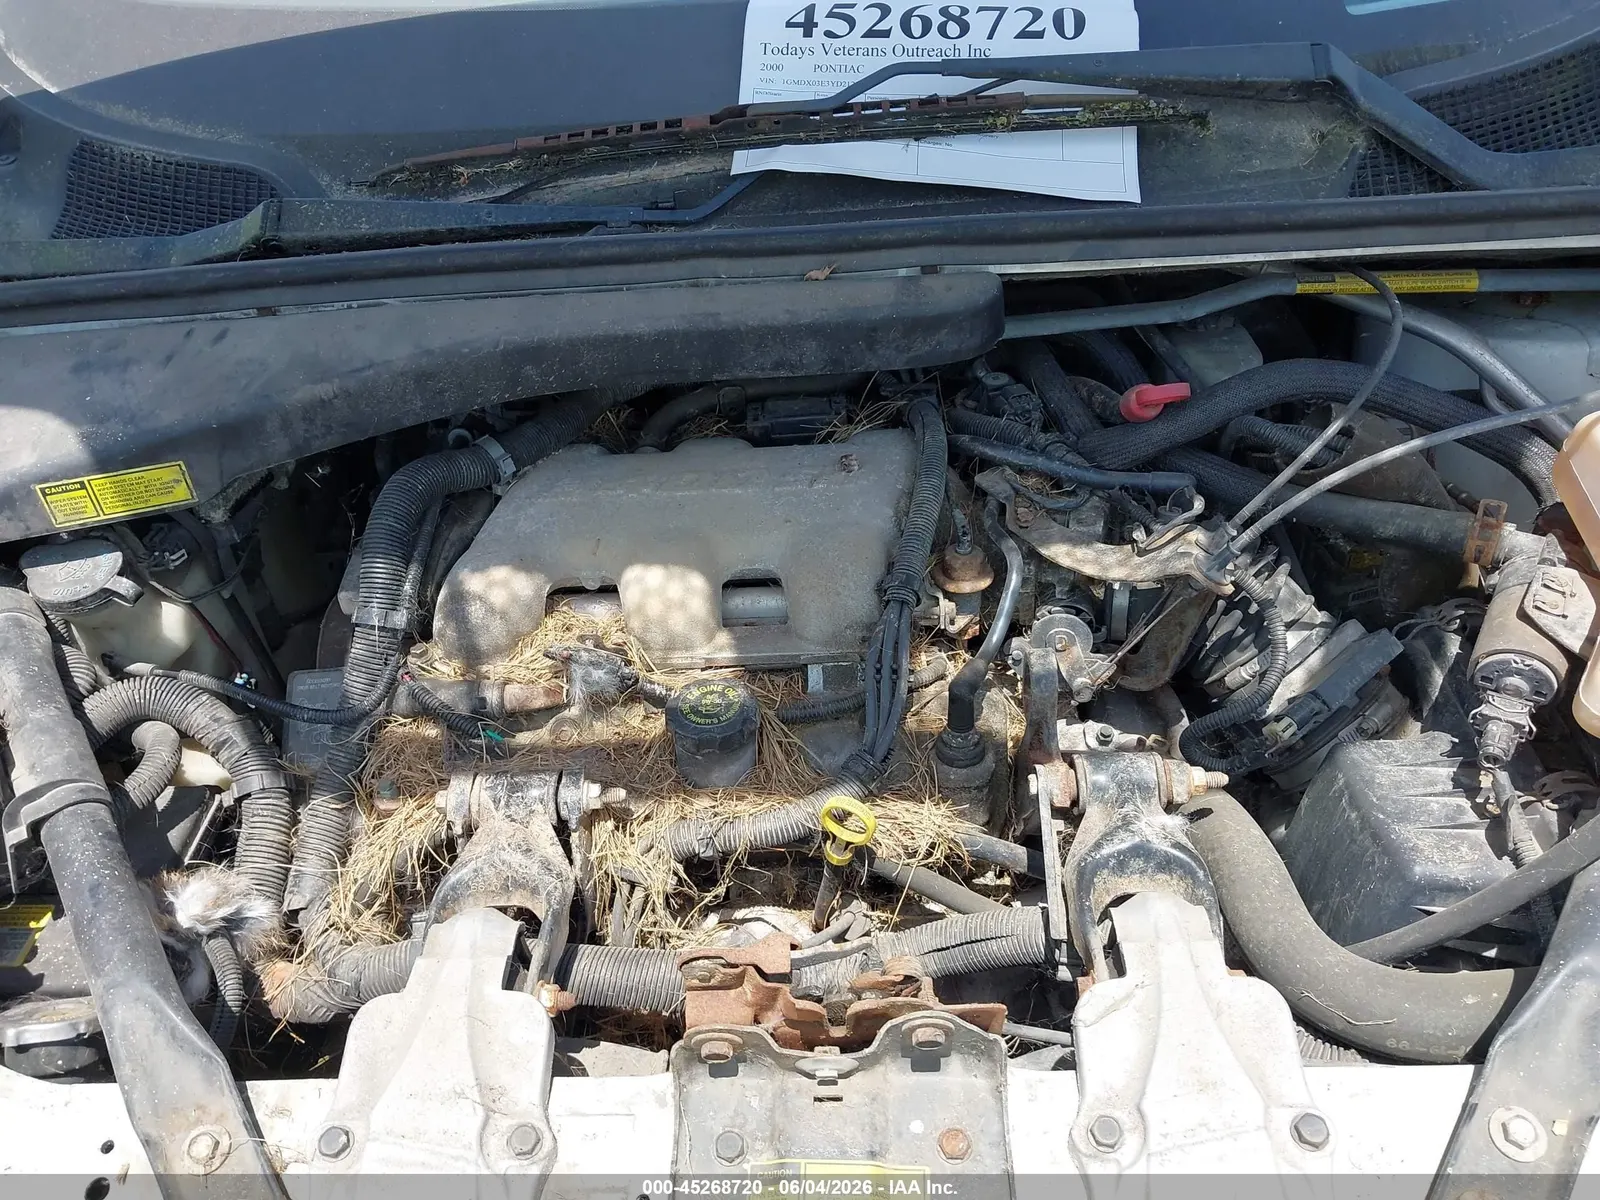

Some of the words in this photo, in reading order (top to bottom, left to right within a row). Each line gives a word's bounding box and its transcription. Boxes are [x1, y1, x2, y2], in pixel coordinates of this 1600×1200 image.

[785, 2, 1086, 40] 45268720
[760, 43, 815, 59] Todays
[820, 43, 887, 57] Veterans
[892, 43, 961, 58] Outreach
[968, 45, 991, 57] Inc
[760, 63, 784, 72] 2000
[813, 64, 865, 74] PONTIAC
[759, 77, 777, 85] VIN:
[45, 483, 81, 494] CAUTION
[110, 491, 135, 499] WHETHER
[687, 684, 724, 700] ENGINE
[757, 1168, 793, 1180] CAUTION
